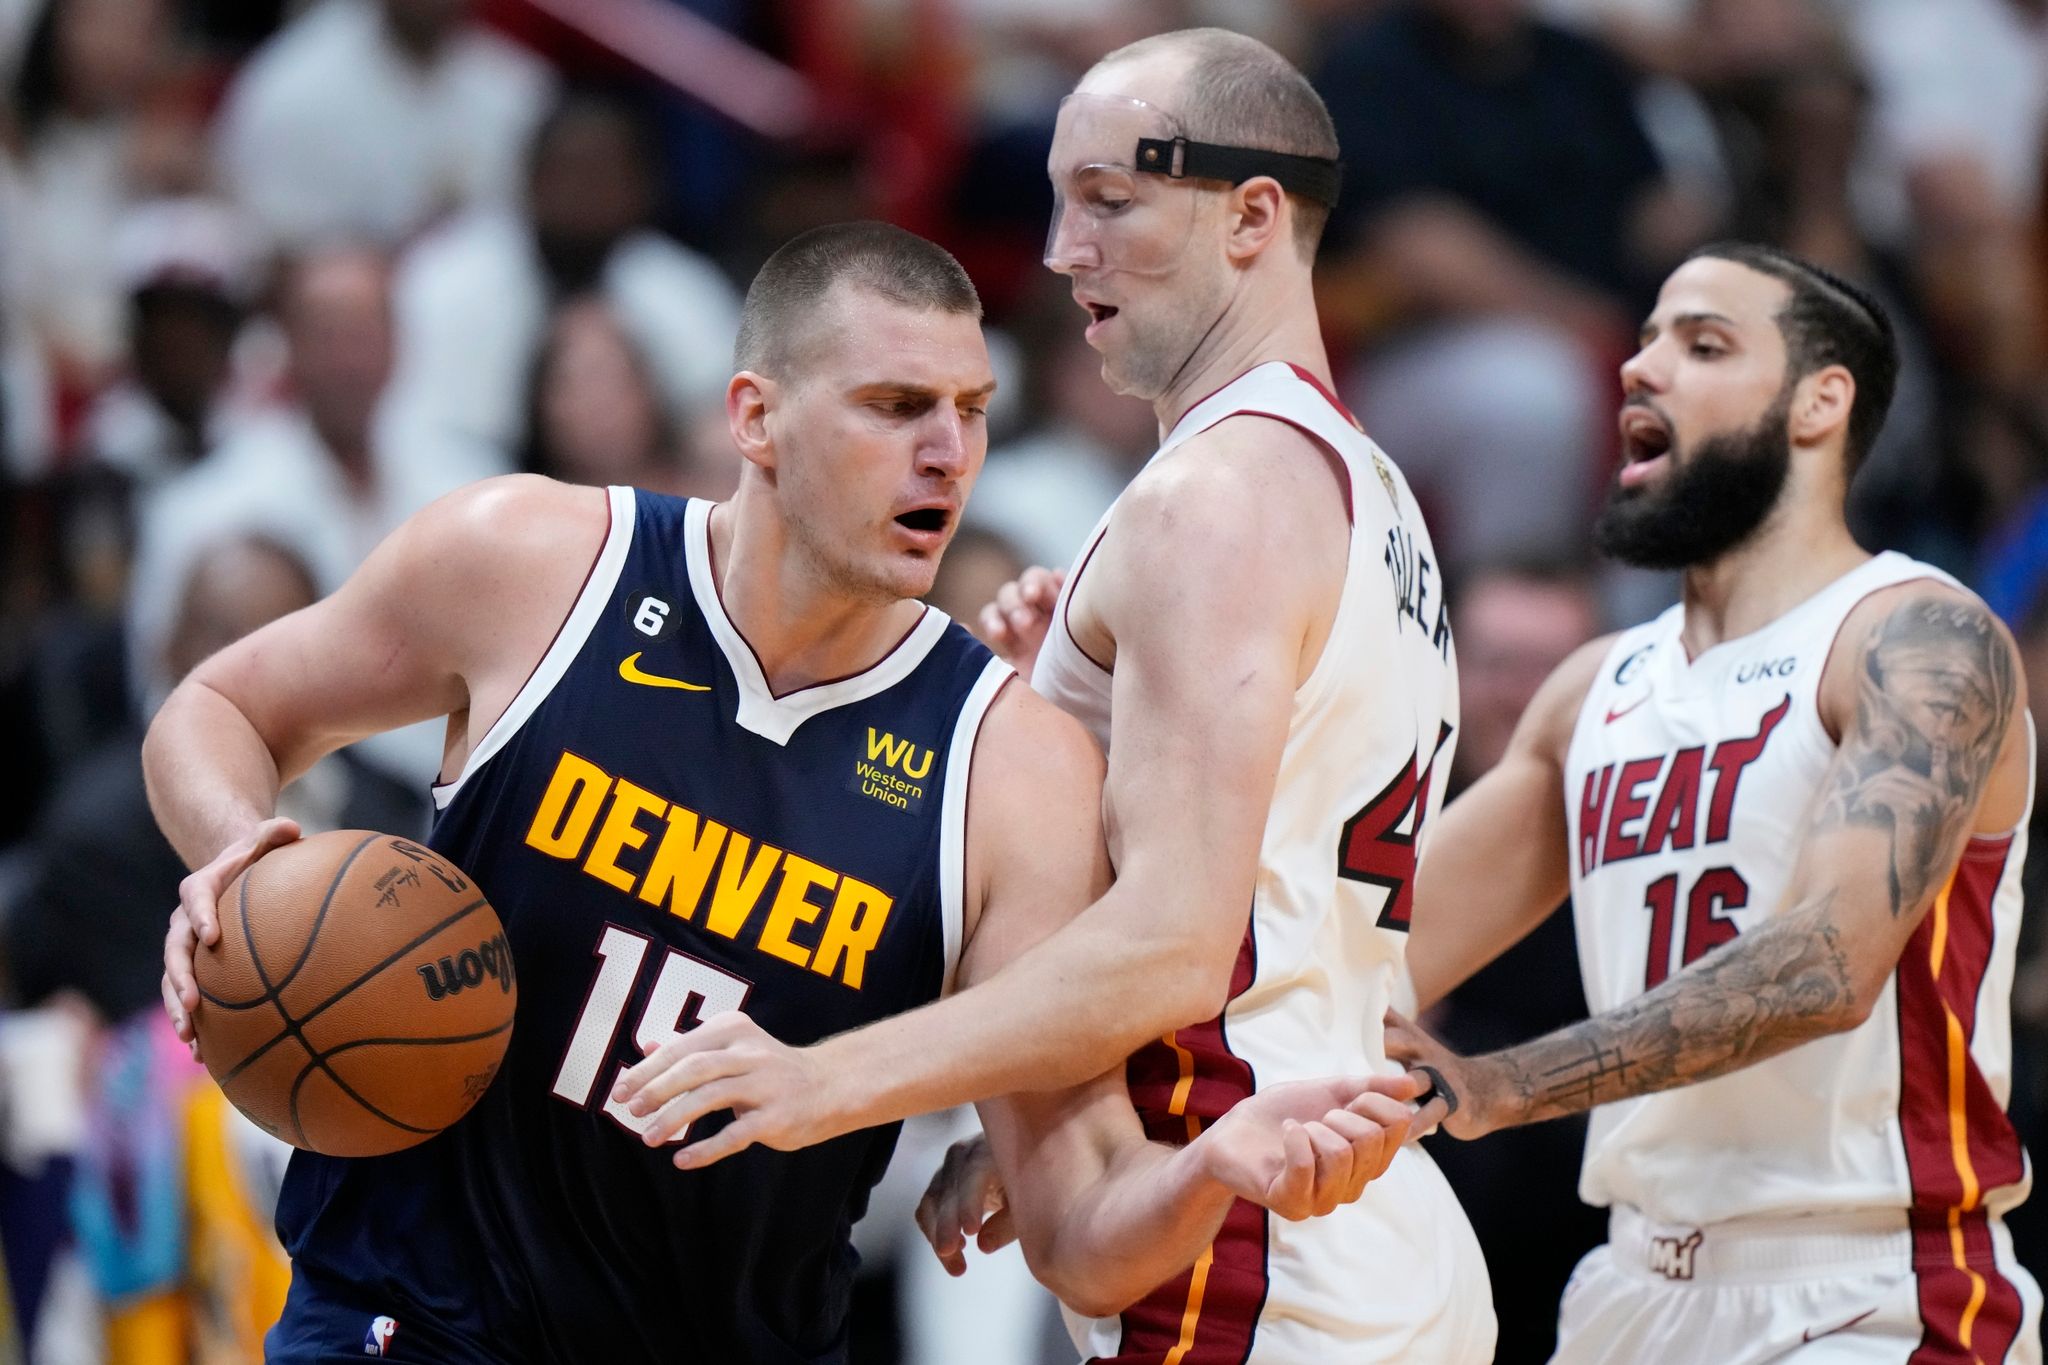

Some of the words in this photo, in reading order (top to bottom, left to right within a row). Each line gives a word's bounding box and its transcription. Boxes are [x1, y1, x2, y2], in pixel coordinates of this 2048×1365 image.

[633, 596, 670, 637] 6
[1736, 656, 1796, 683] UKG
[867, 726, 935, 779] WU
[856, 760, 923, 799] Western
[862, 779, 908, 809] Union
[1579, 693, 1791, 878] HEAT
[525, 749, 894, 990] DENVER
[1645, 866, 1749, 992] 16
